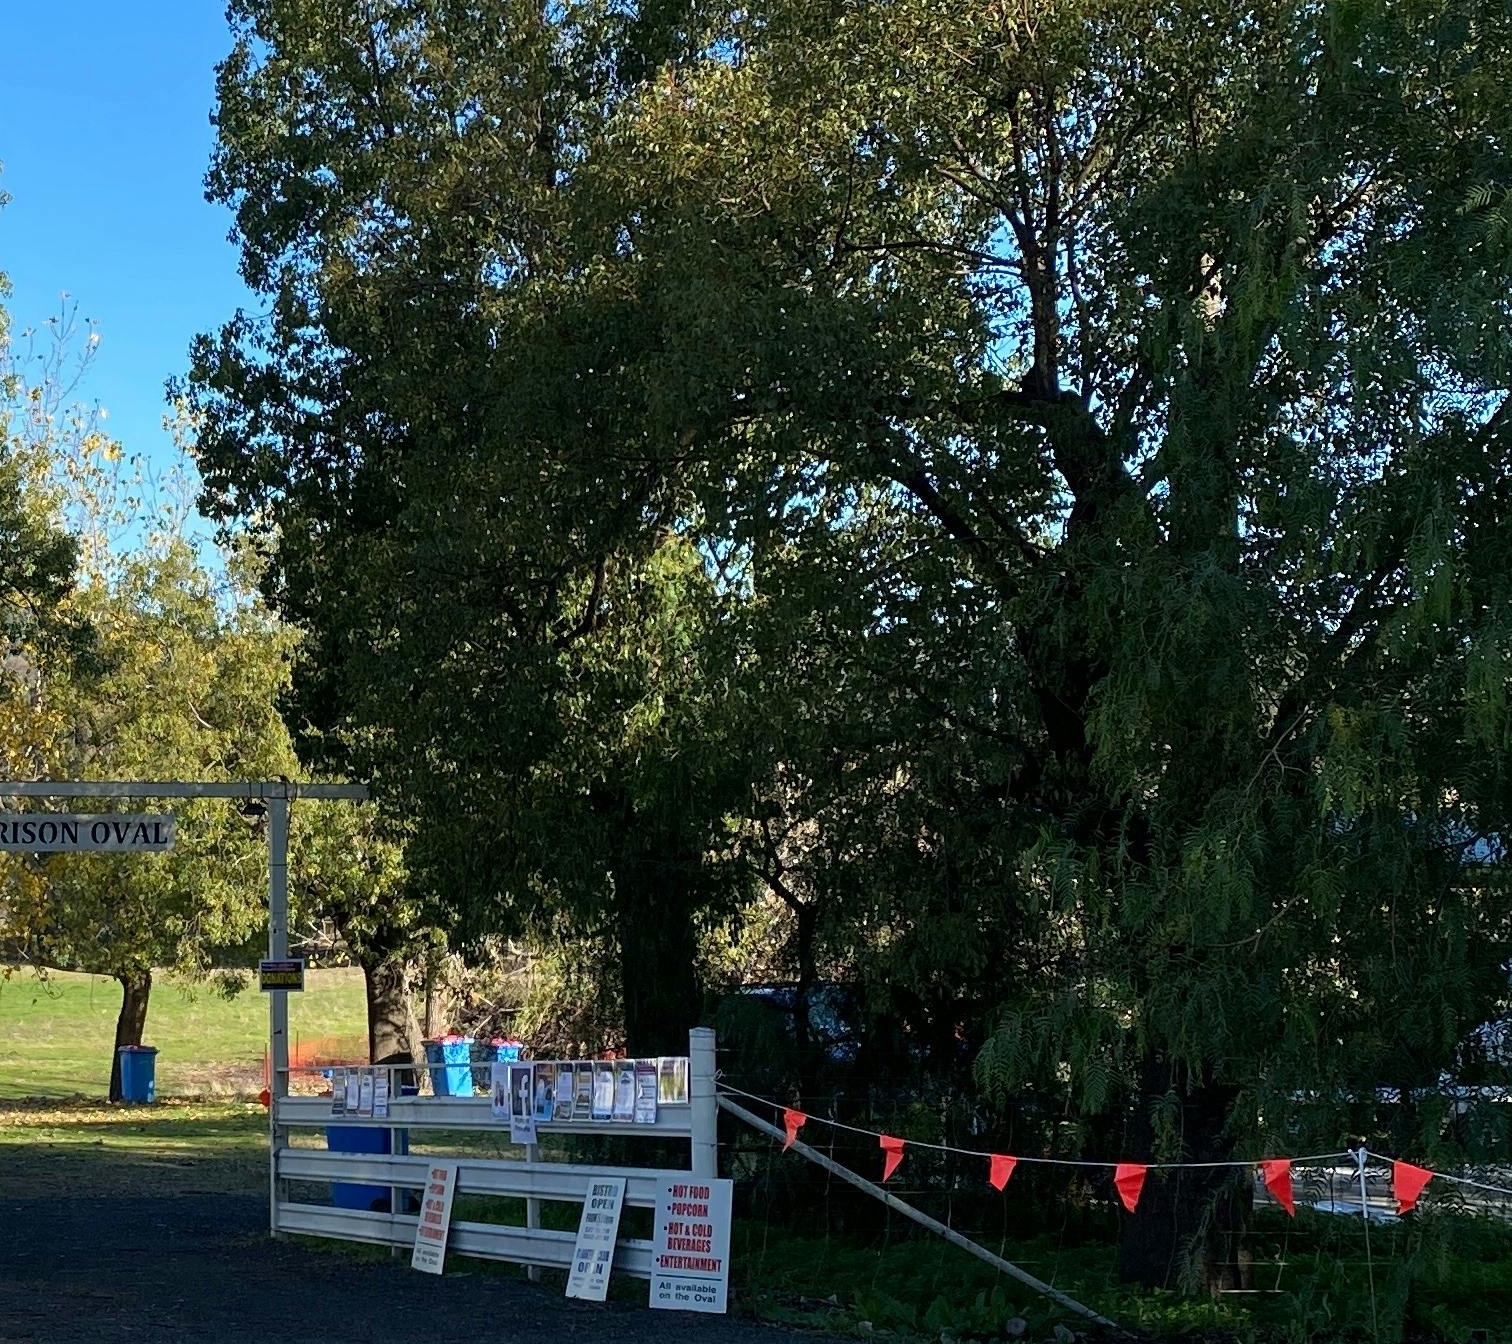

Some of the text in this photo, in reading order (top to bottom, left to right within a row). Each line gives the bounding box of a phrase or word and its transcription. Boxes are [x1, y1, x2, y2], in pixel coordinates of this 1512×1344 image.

[90, 821, 169, 845] OVAL
[672, 1184, 710, 1199] HOT FOOD
[591, 1198, 615, 1209] OPEN
[671, 1202, 709, 1217] POPCORN
[668, 1222, 684, 1236] HOT
[692, 1223, 713, 1237] COLD
[668, 1237, 711, 1253] BEVERAGES
[578, 1261, 604, 1275] OPN
[660, 1255, 722, 1272] ENTERTAINMENT
[659, 1281, 717, 1294] All available
[675, 1292, 690, 1301] the
[694, 1294, 716, 1303] Oval
